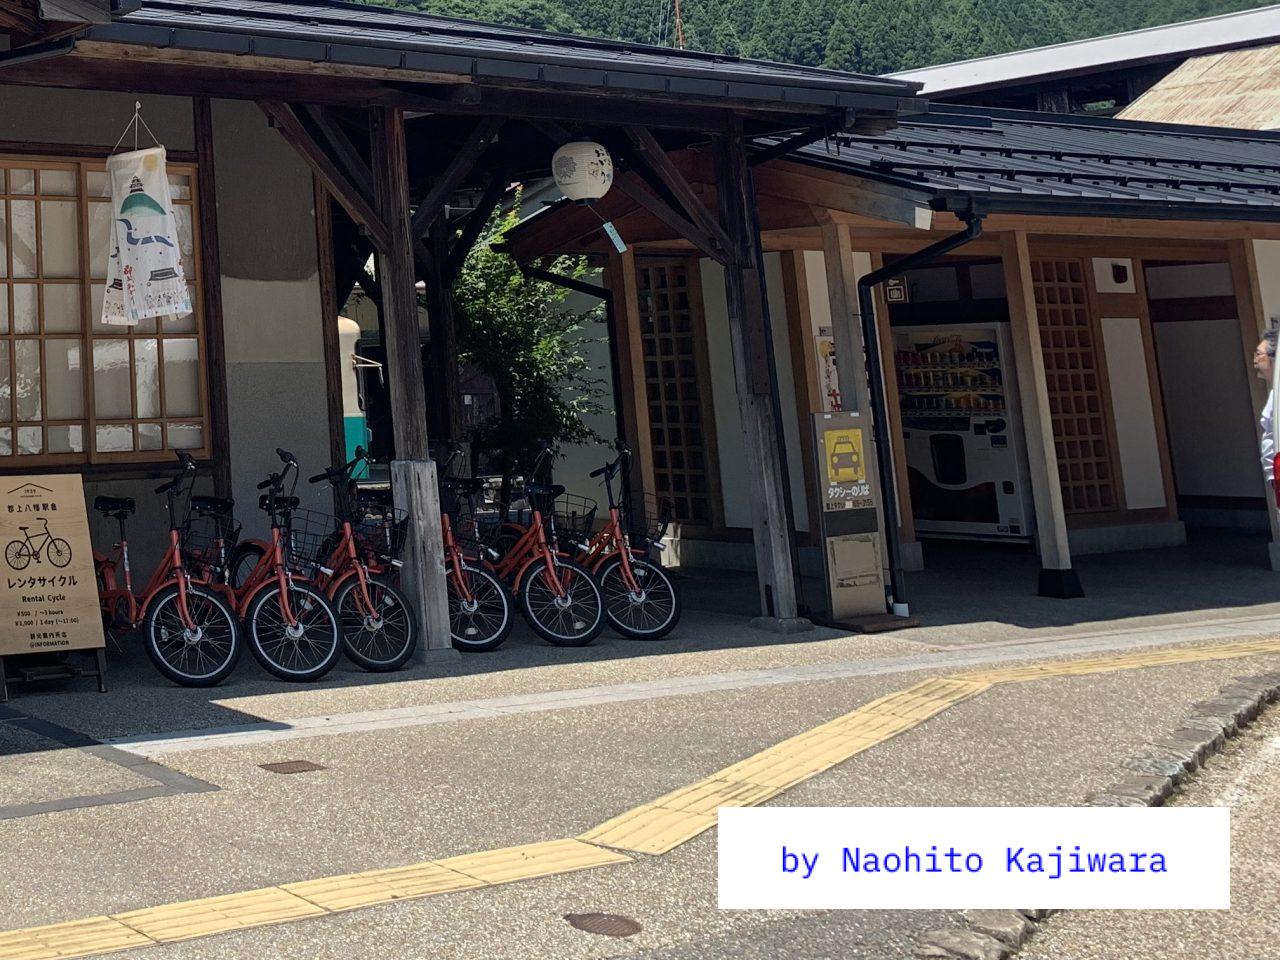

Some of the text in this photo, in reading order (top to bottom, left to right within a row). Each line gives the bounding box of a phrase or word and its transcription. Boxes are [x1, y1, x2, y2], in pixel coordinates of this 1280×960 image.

[828, 484, 870, 499] タクシーのりば
[7, 575, 78, 589] レンタサイクル
[22, 593, 66, 604] Rental Cycle
